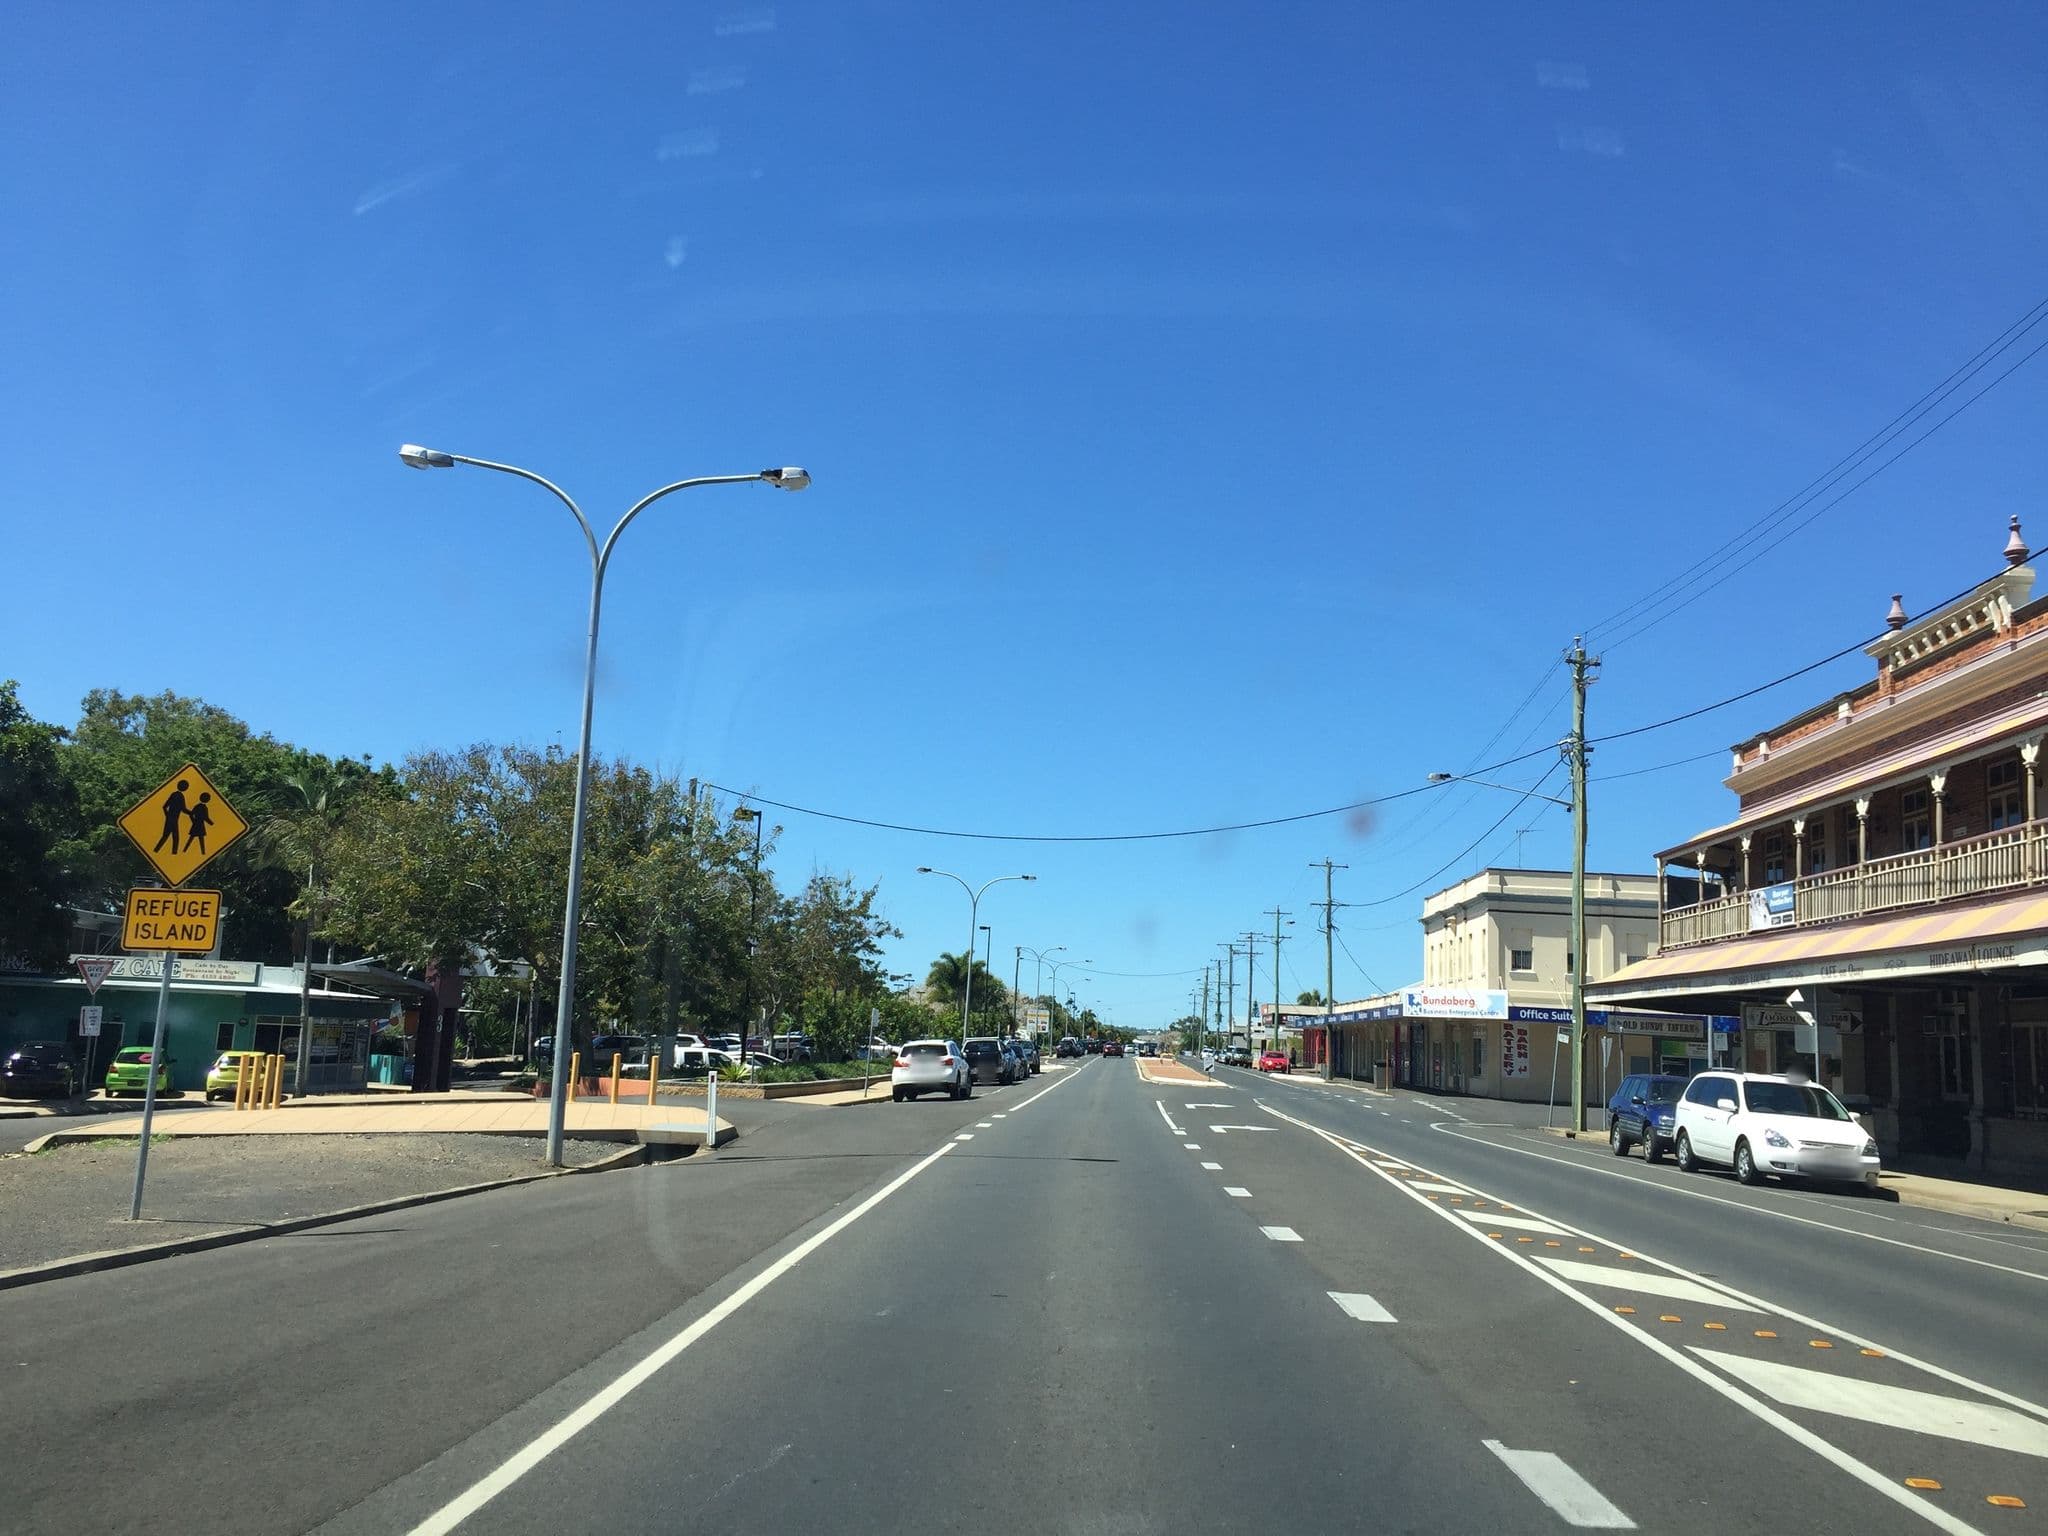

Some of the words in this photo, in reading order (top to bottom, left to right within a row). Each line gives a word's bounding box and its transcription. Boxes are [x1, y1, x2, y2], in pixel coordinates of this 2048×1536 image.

[136, 899, 211, 918] REFUGE
[134, 923, 207, 941] ISLAND
[1929, 948, 1974, 969] HIDEAWAY
[1977, 945, 2015, 964] LOUNGE
[1422, 995, 1476, 1009] Bundaberg
[1449, 1008, 1478, 1016] Enterprise
[1519, 1009, 1549, 1020] Office
[1623, 1020, 1638, 1030] OLD
[1667, 1023, 1695, 1033] TAVERN
[1503, 1023, 1514, 1076] BATTERY
[1517, 1028, 1528, 1059] BARN
